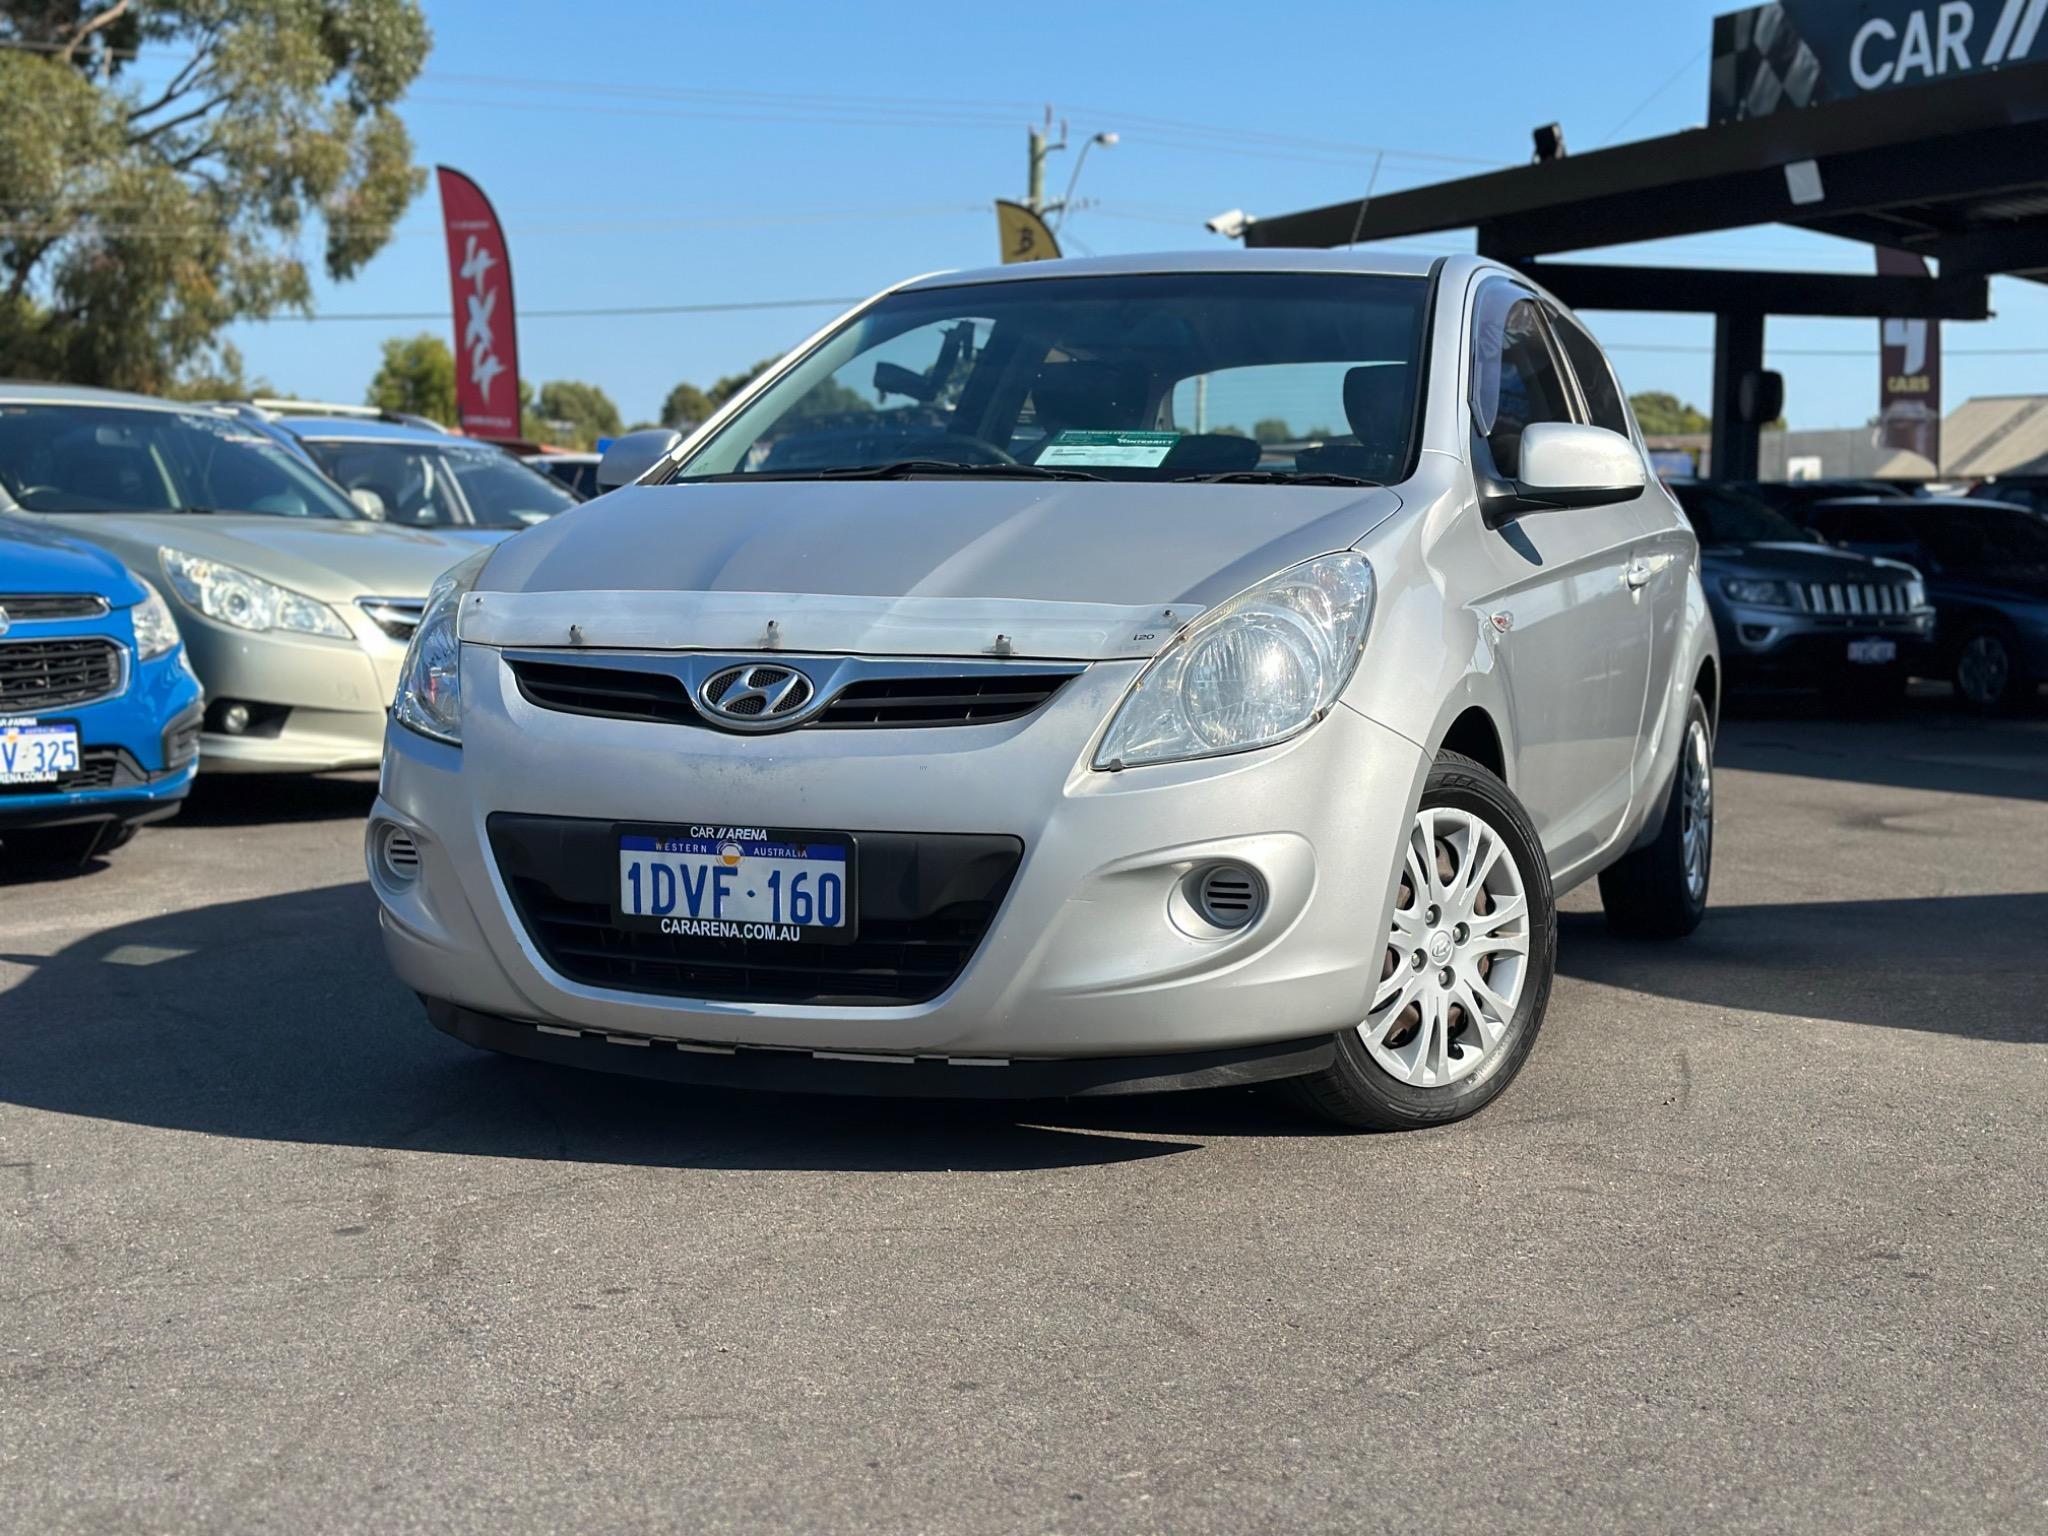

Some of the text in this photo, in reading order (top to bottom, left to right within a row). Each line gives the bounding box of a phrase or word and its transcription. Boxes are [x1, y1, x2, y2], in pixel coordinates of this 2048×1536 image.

[1850, 1, 1974, 89] CAR
[32, 741, 76, 772] 325
[690, 826, 715, 839] CAR
[655, 842, 808, 859] WESTERN AUSTRALIA
[660, 918, 800, 942] CARARENA.COM.AU
